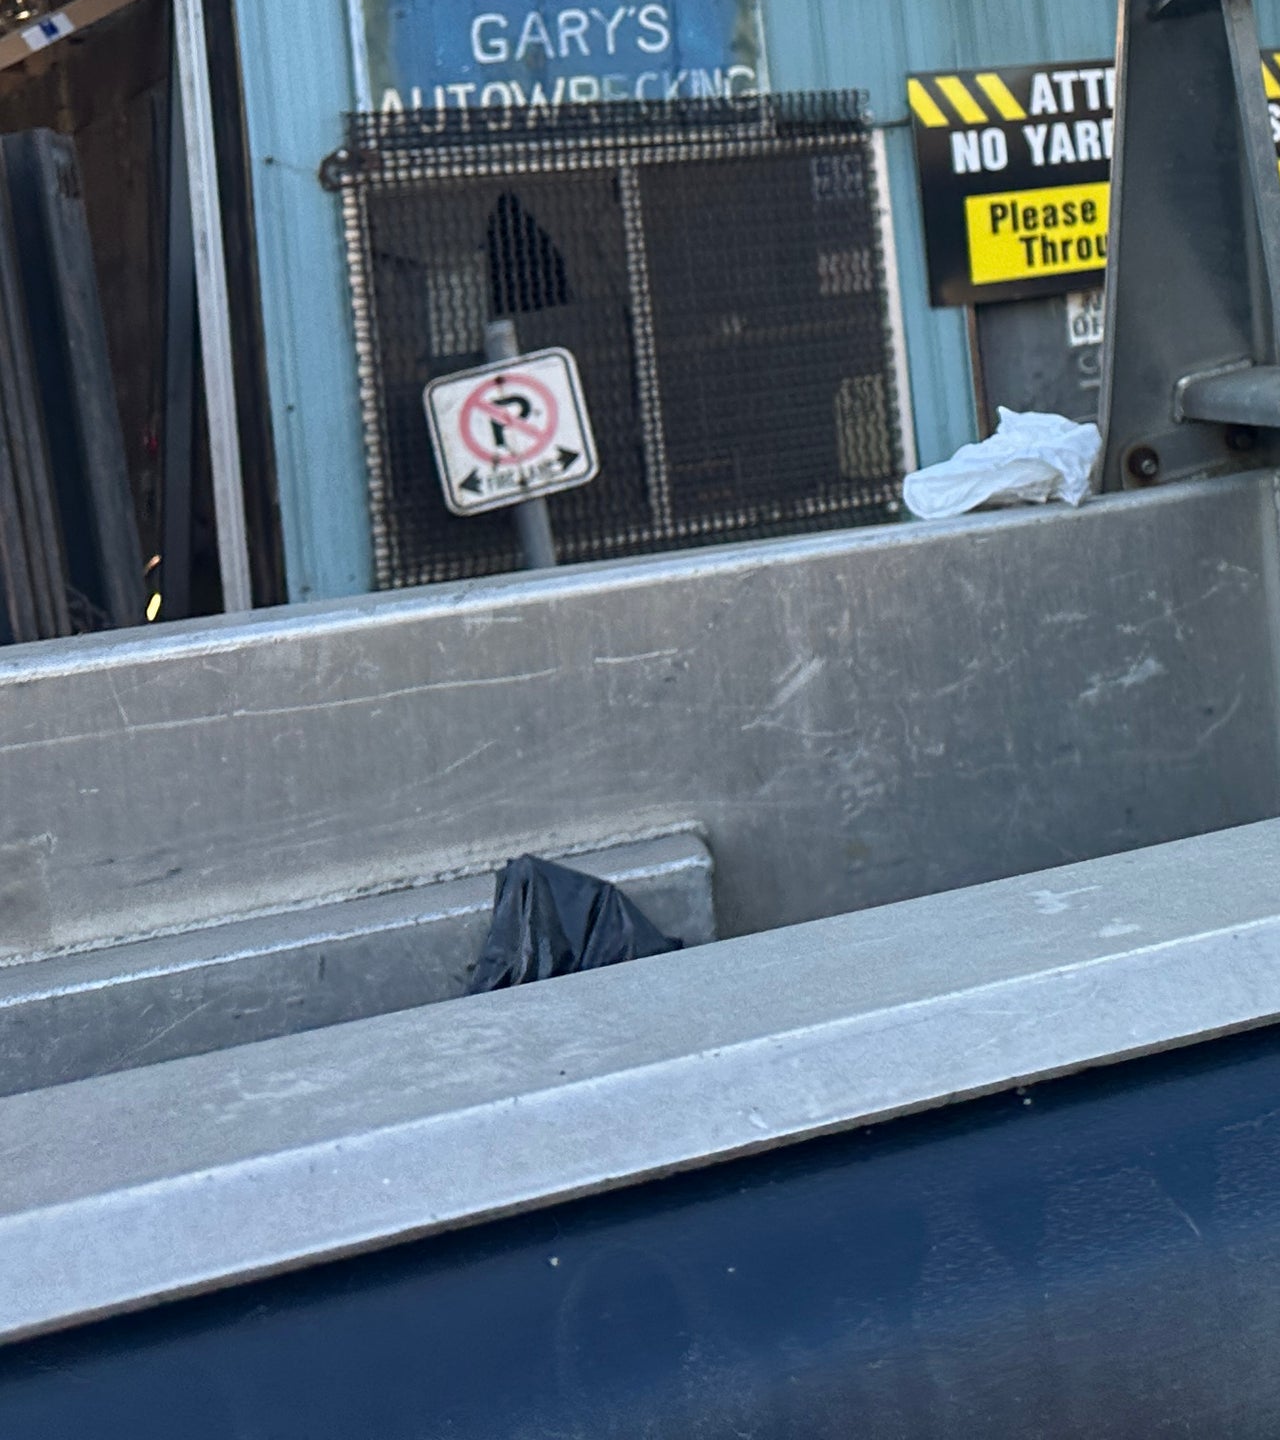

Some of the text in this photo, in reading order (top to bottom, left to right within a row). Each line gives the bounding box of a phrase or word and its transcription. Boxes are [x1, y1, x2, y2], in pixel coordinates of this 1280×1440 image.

[470, 4, 671, 64] GARY'S
[1030, 67, 1116, 116] ATT
[951, 129, 1007, 174] NO
[990, 193, 1097, 236] Please
